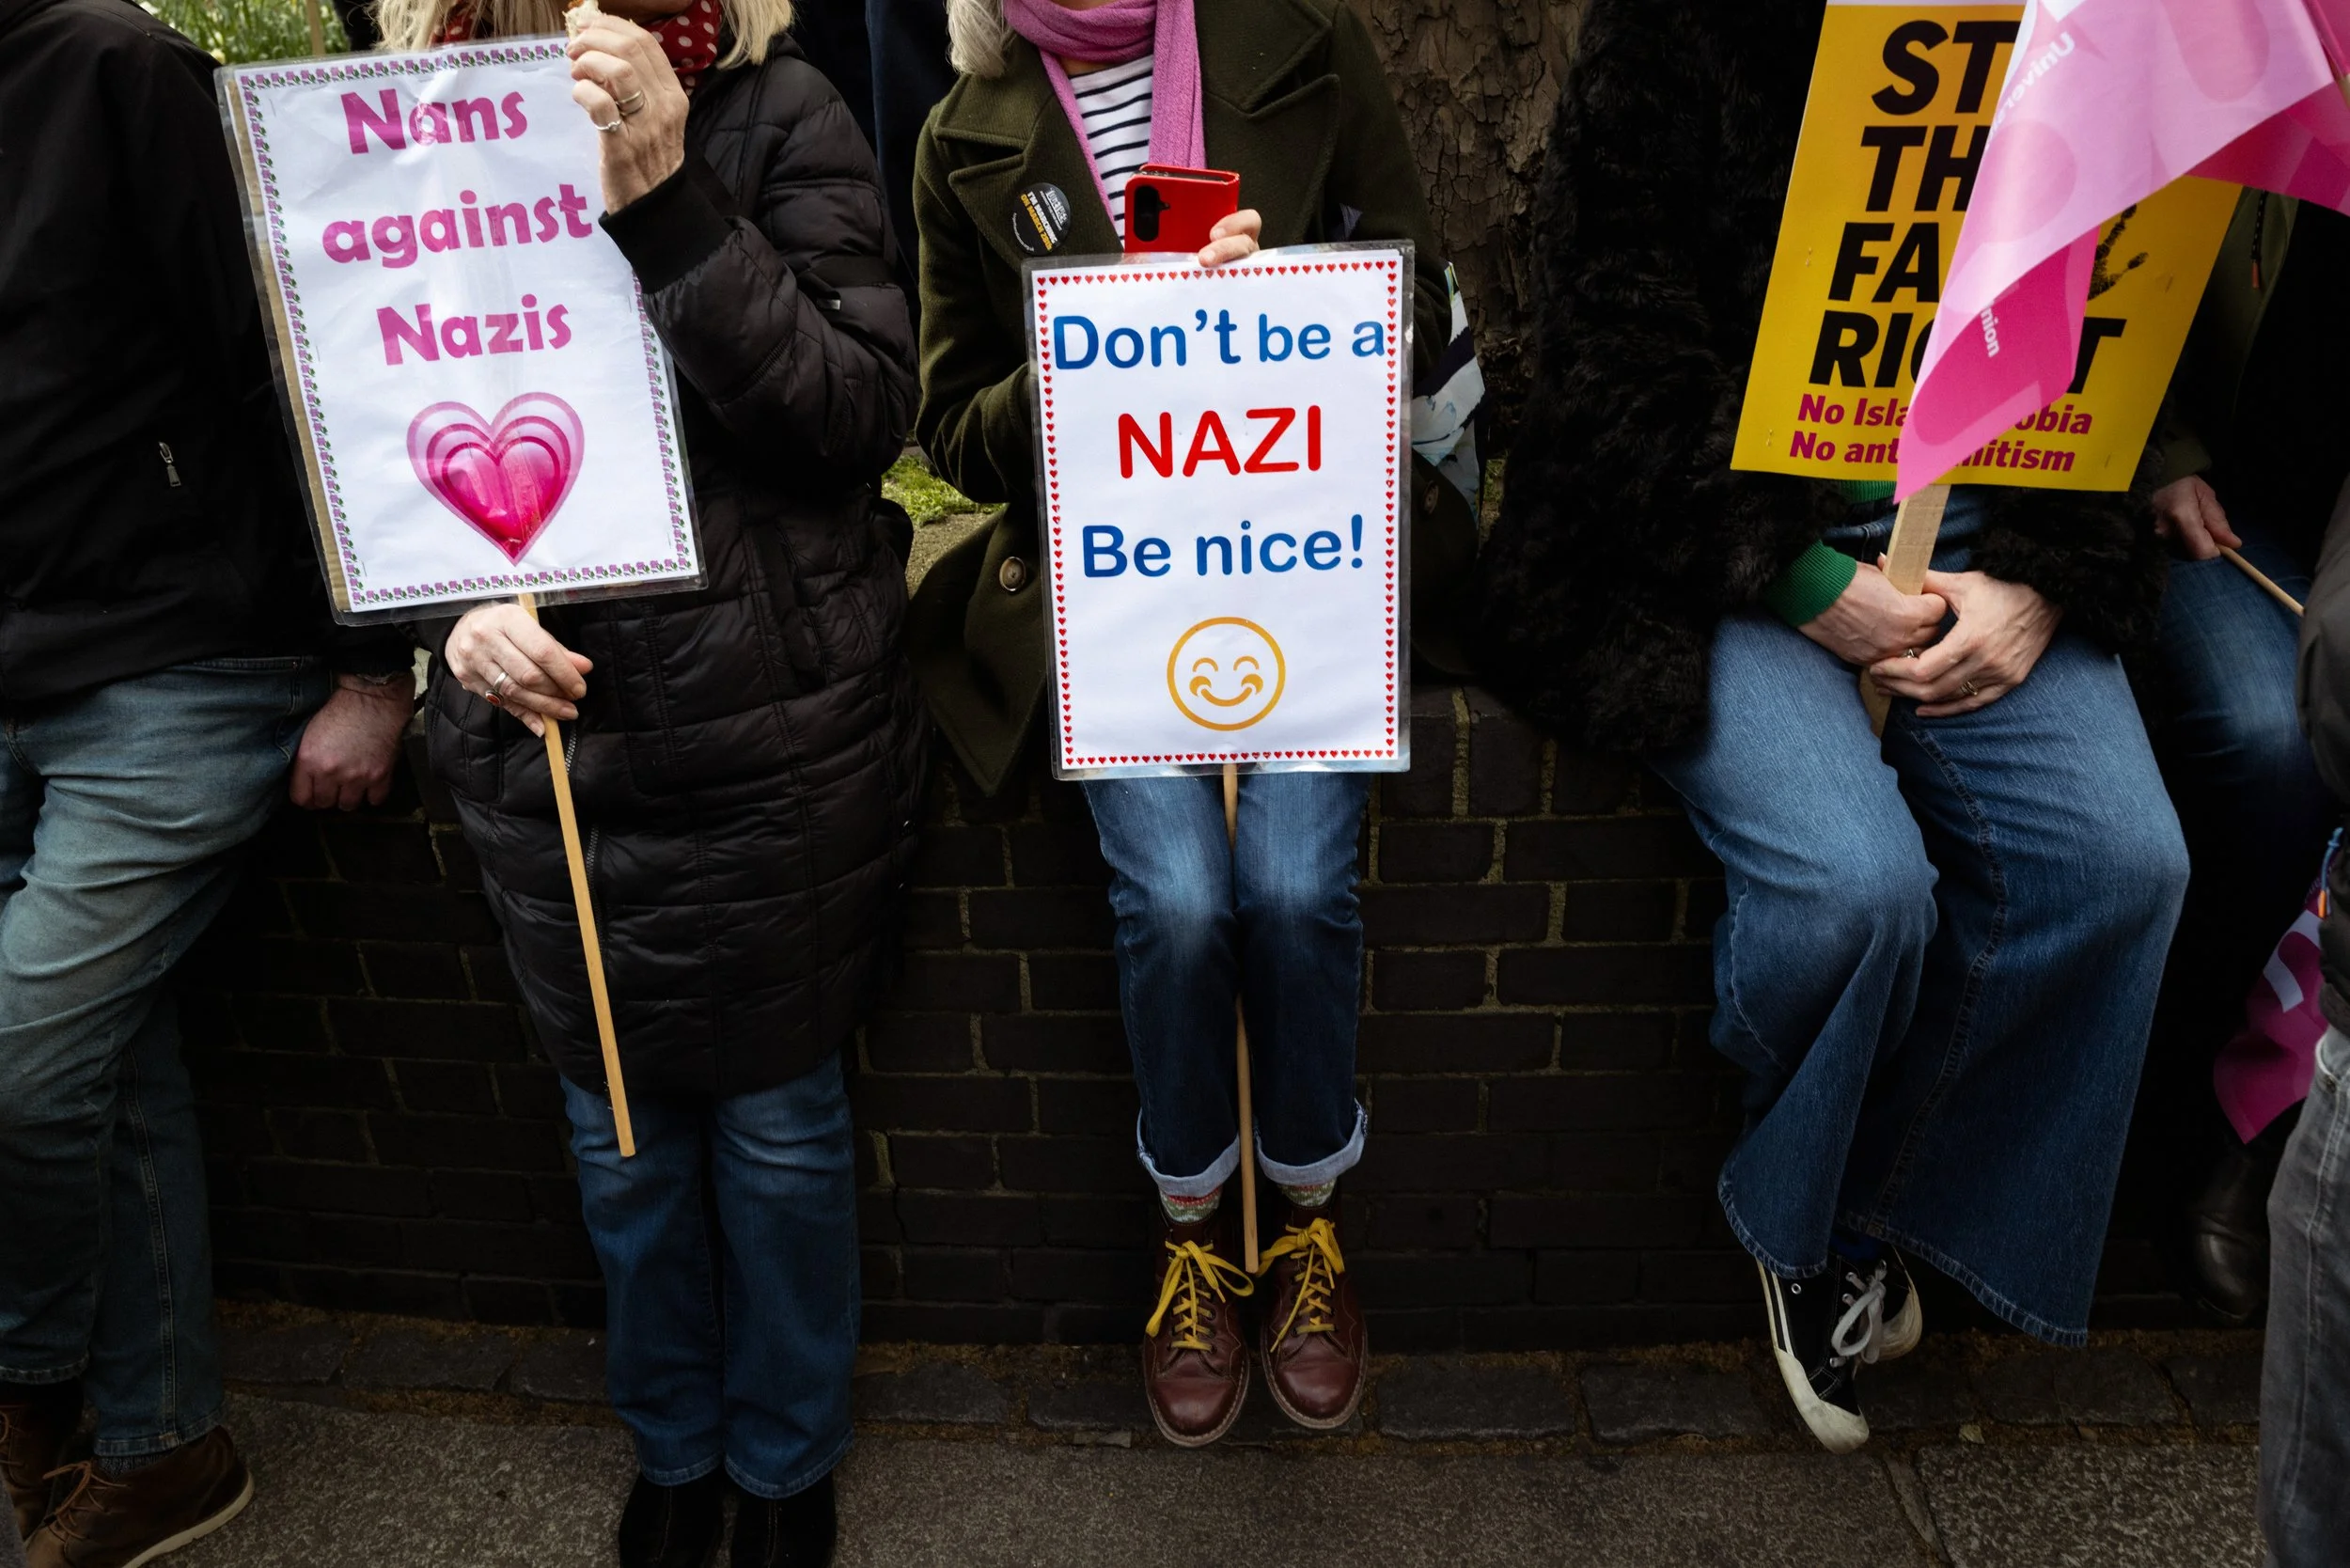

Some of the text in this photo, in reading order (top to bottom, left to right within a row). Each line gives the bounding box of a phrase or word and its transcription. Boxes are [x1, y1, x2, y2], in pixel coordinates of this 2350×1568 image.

[1872, 20, 2021, 116] ST
[341, 88, 528, 155] Nans
[1860, 125, 1991, 212] TH
[322, 183, 593, 269] against
[1026, 205, 1044, 234] MARCH
[1828, 222, 1940, 304] FA
[376, 293, 572, 366] Nazis
[1053, 308, 1386, 370] Don't be a
[1809, 309, 2127, 395] RIT
[1980, 303, 1999, 358] nion
[1117, 404, 1322, 479] NAZI
[1798, 394, 2093, 435] No Islaobia
[1790, 431, 2076, 472] No antitism
[1082, 513, 1364, 579] Be nice!
